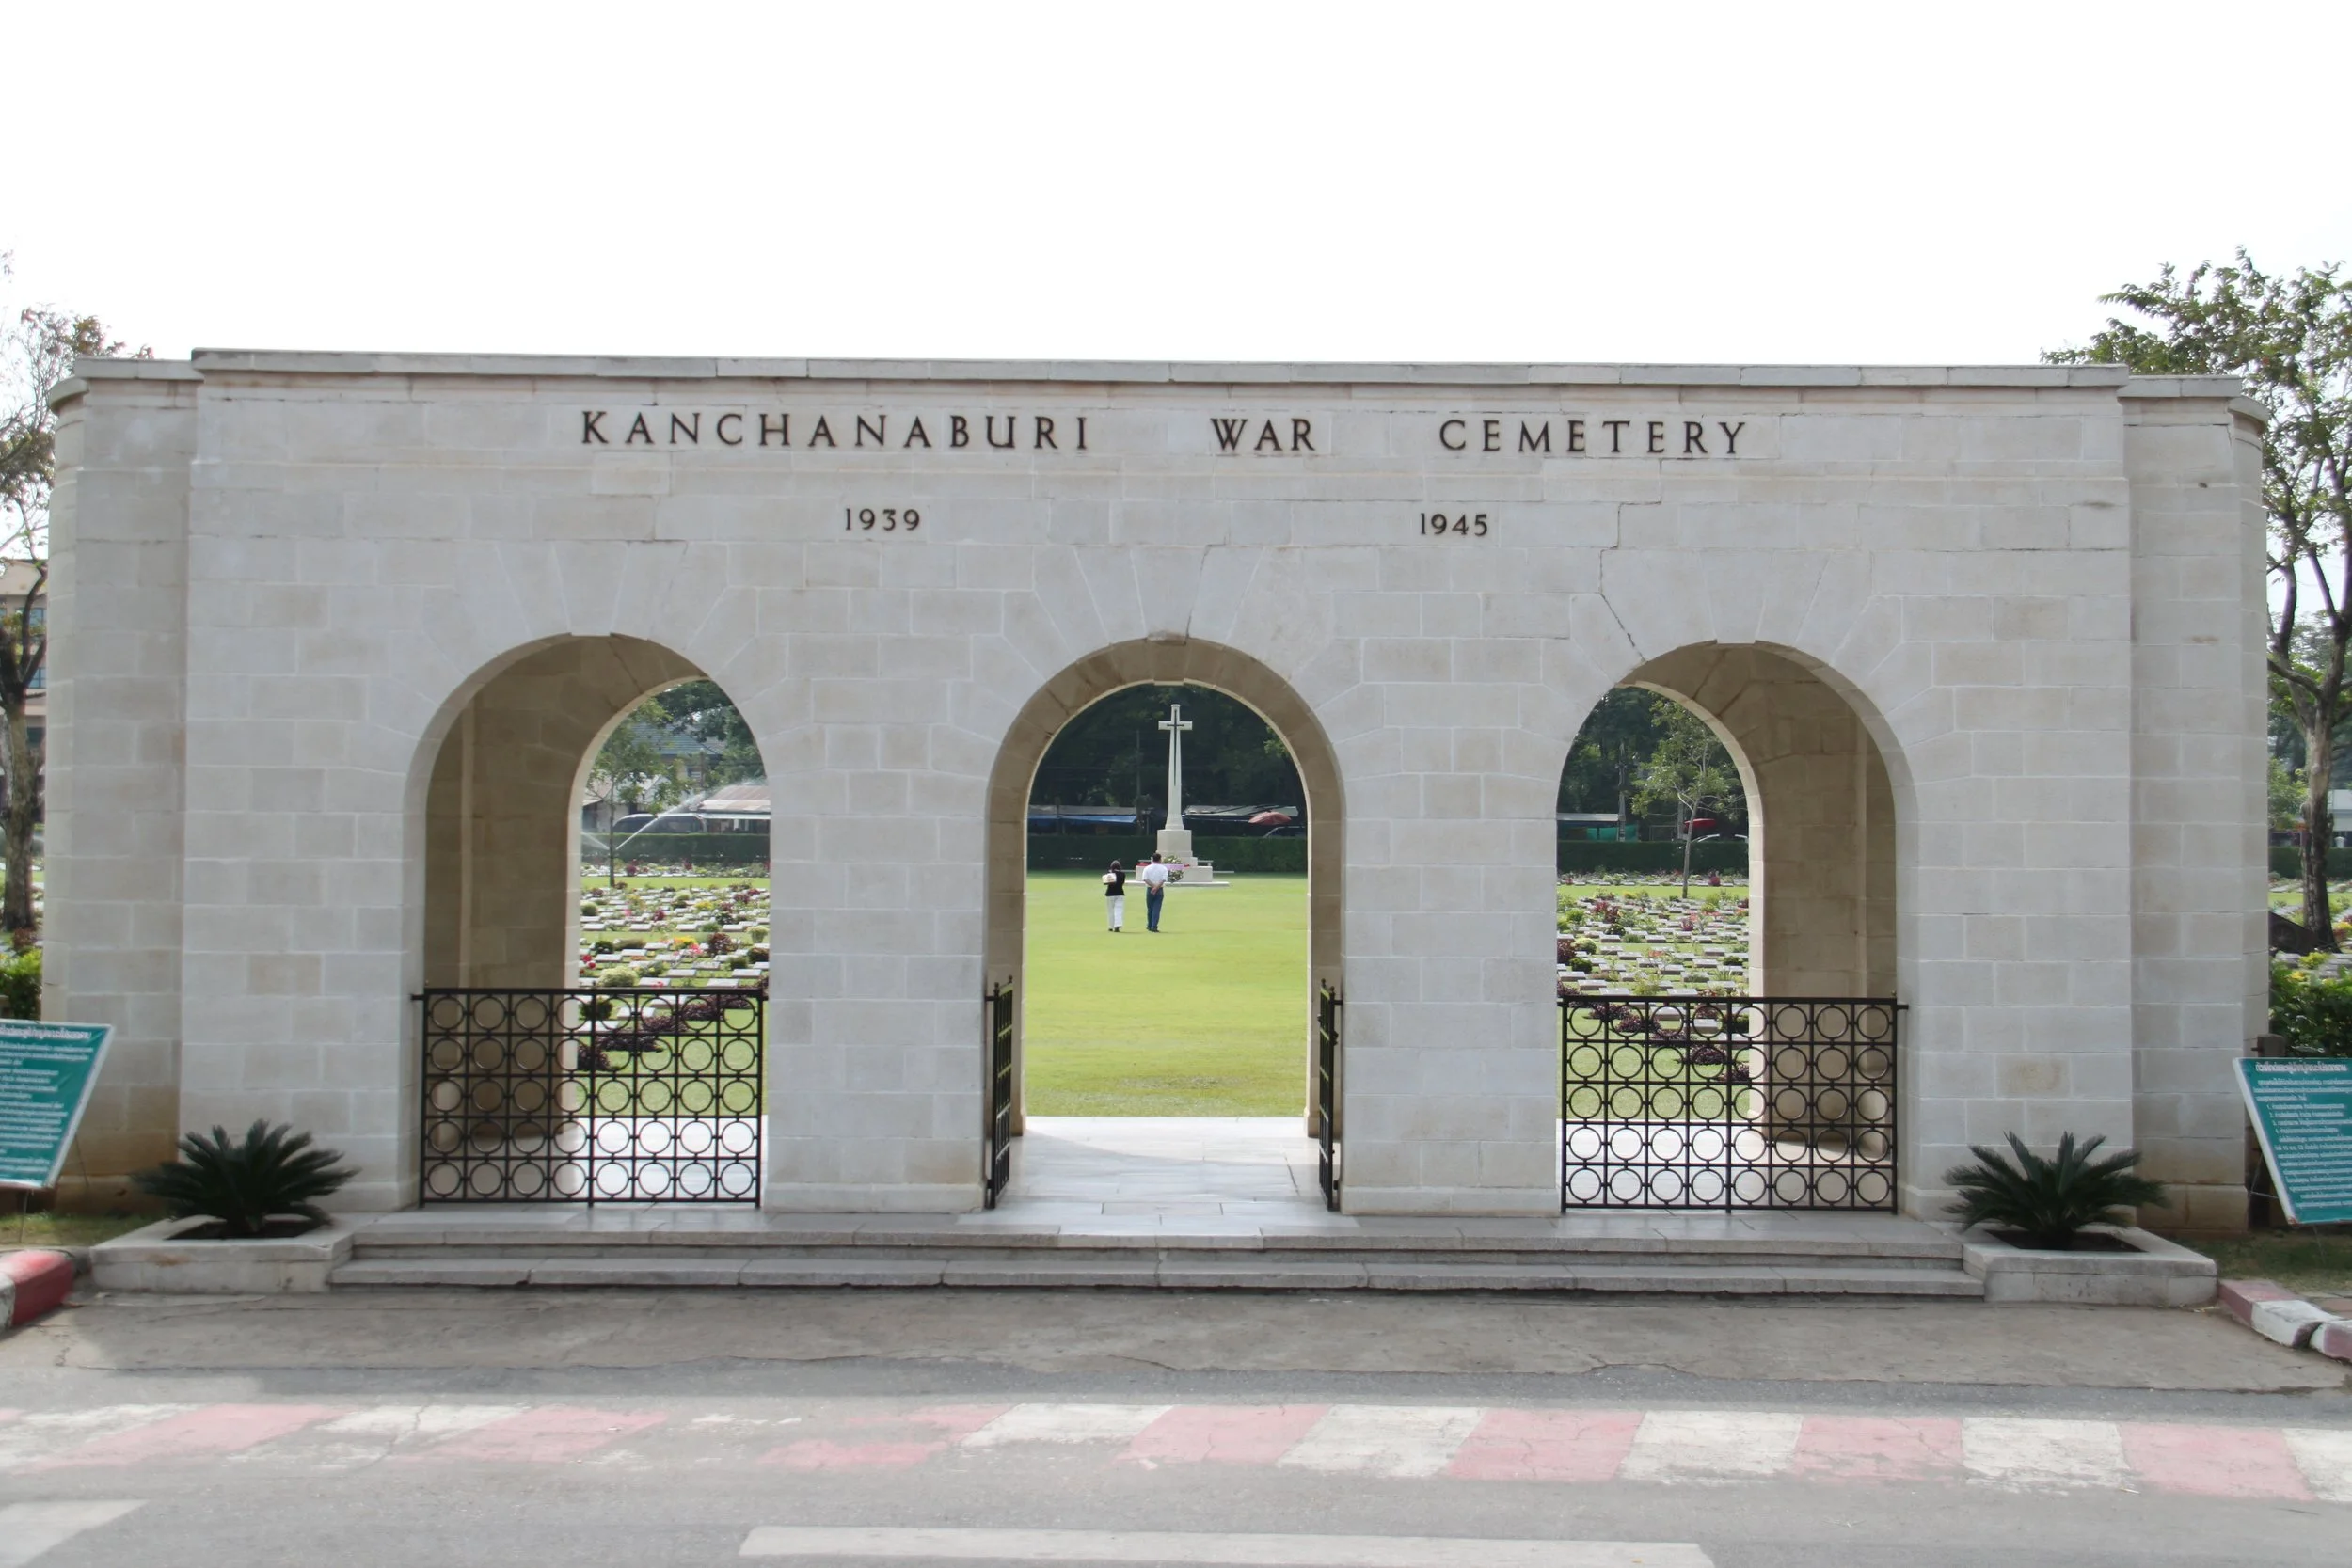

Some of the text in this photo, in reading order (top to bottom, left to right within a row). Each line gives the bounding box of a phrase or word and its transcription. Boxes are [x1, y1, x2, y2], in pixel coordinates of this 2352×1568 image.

[582, 410, 1747, 455] KANCHANABURI WAR CEMETERY
[845, 508, 921, 531] 1939
[1421, 513, 1489, 537] 1945
